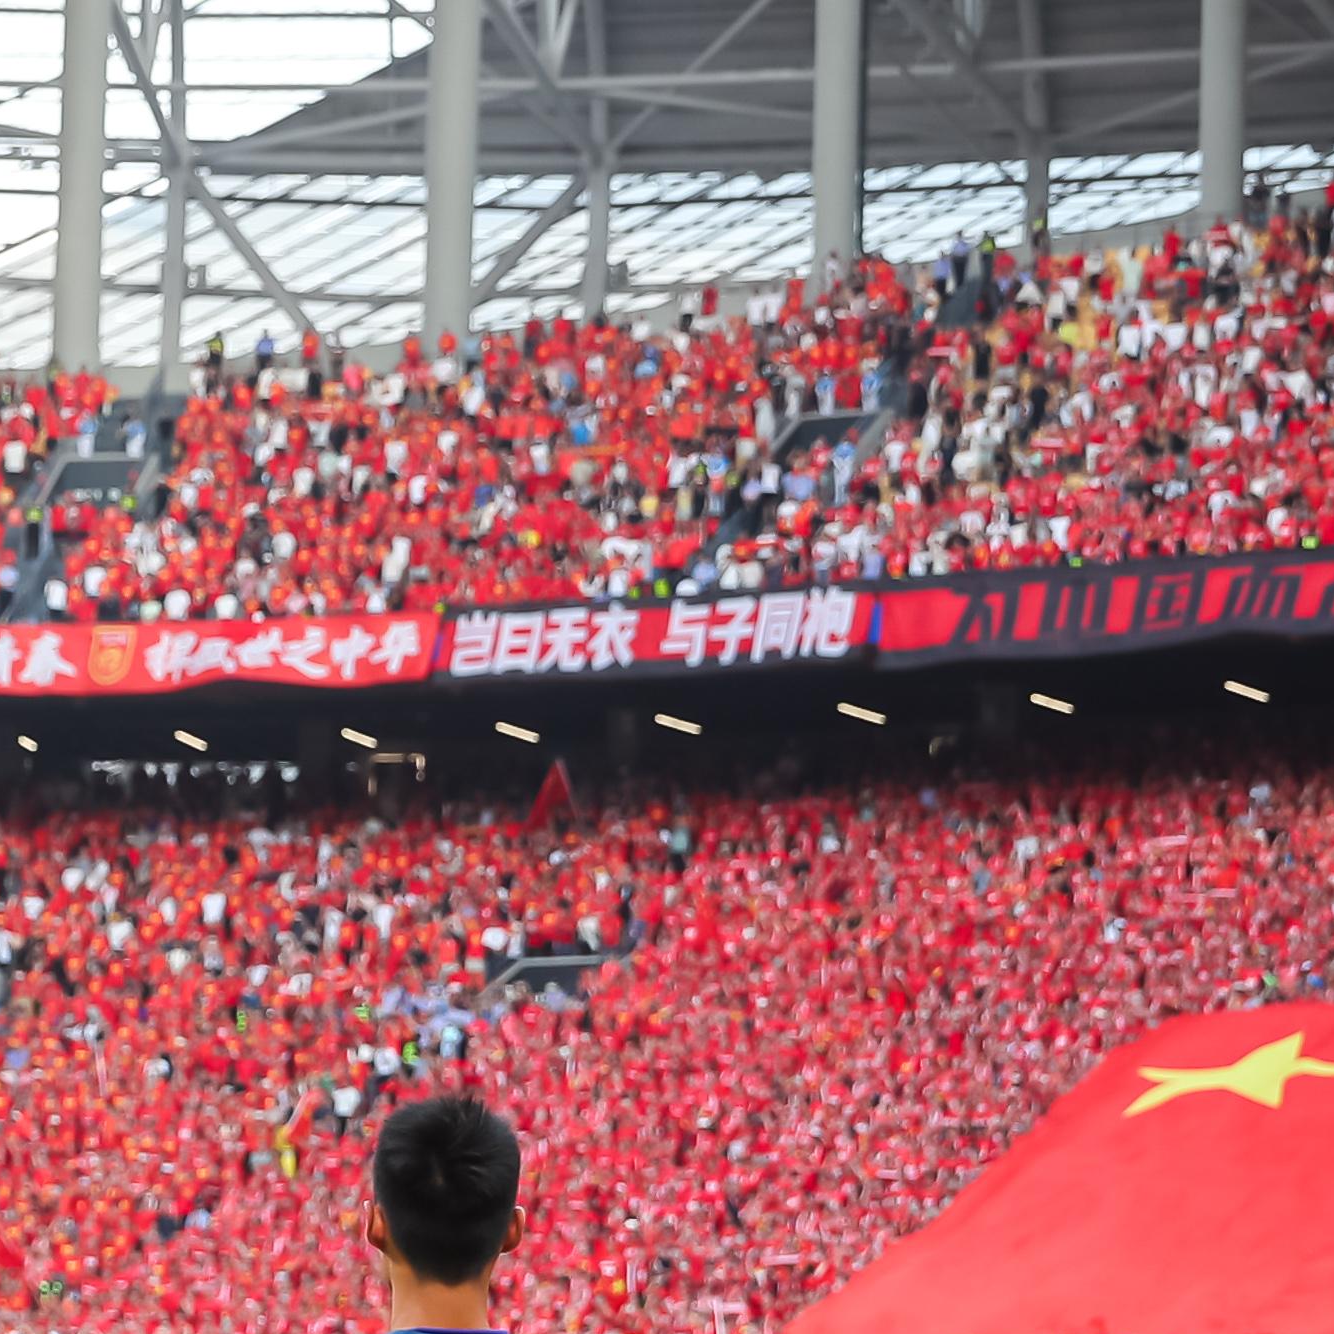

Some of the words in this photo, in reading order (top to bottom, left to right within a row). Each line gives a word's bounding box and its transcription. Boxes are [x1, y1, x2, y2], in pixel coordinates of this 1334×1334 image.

[450, 600, 639, 677] 岂曰无衣
[660, 585, 856, 668] 与子同袍
